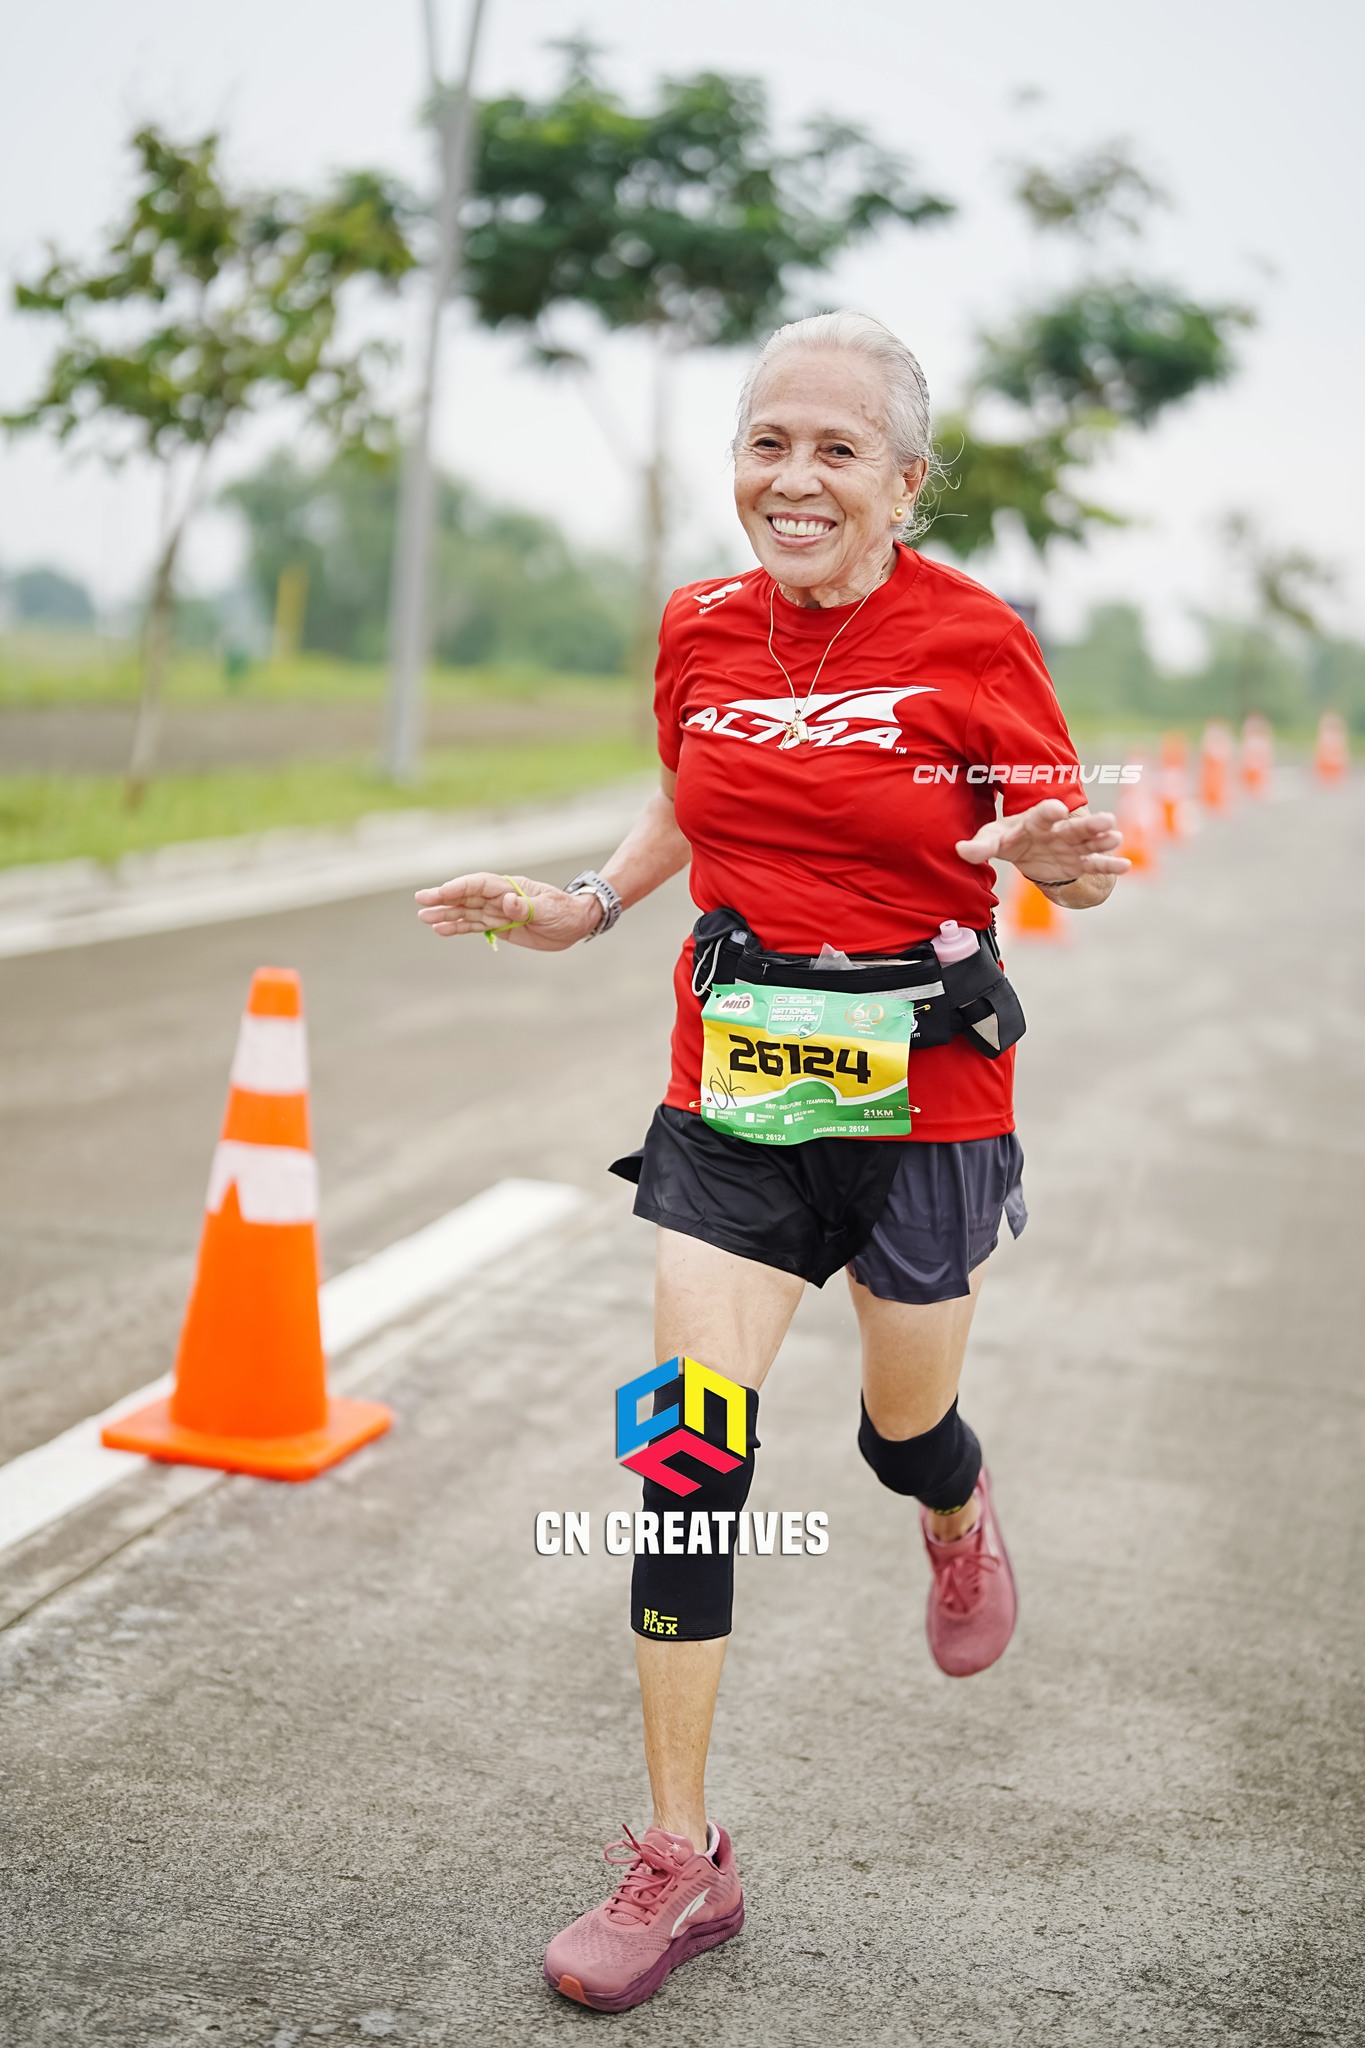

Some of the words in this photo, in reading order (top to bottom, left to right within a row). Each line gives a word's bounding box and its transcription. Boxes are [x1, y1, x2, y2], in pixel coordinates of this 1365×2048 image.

[684, 706, 902, 750] ALTRA
[722, 999, 751, 1009] MILO
[771, 1007, 816, 1016] NATIONAL
[770, 1014, 819, 1023] MARATHON
[728, 1033, 871, 1085] 26124
[813, 1126, 836, 1134] BAGGAGE
[849, 1125, 870, 1133] 26124
[766, 1133, 786, 1141] 26124
[643, 1620, 678, 1635] FLEX
